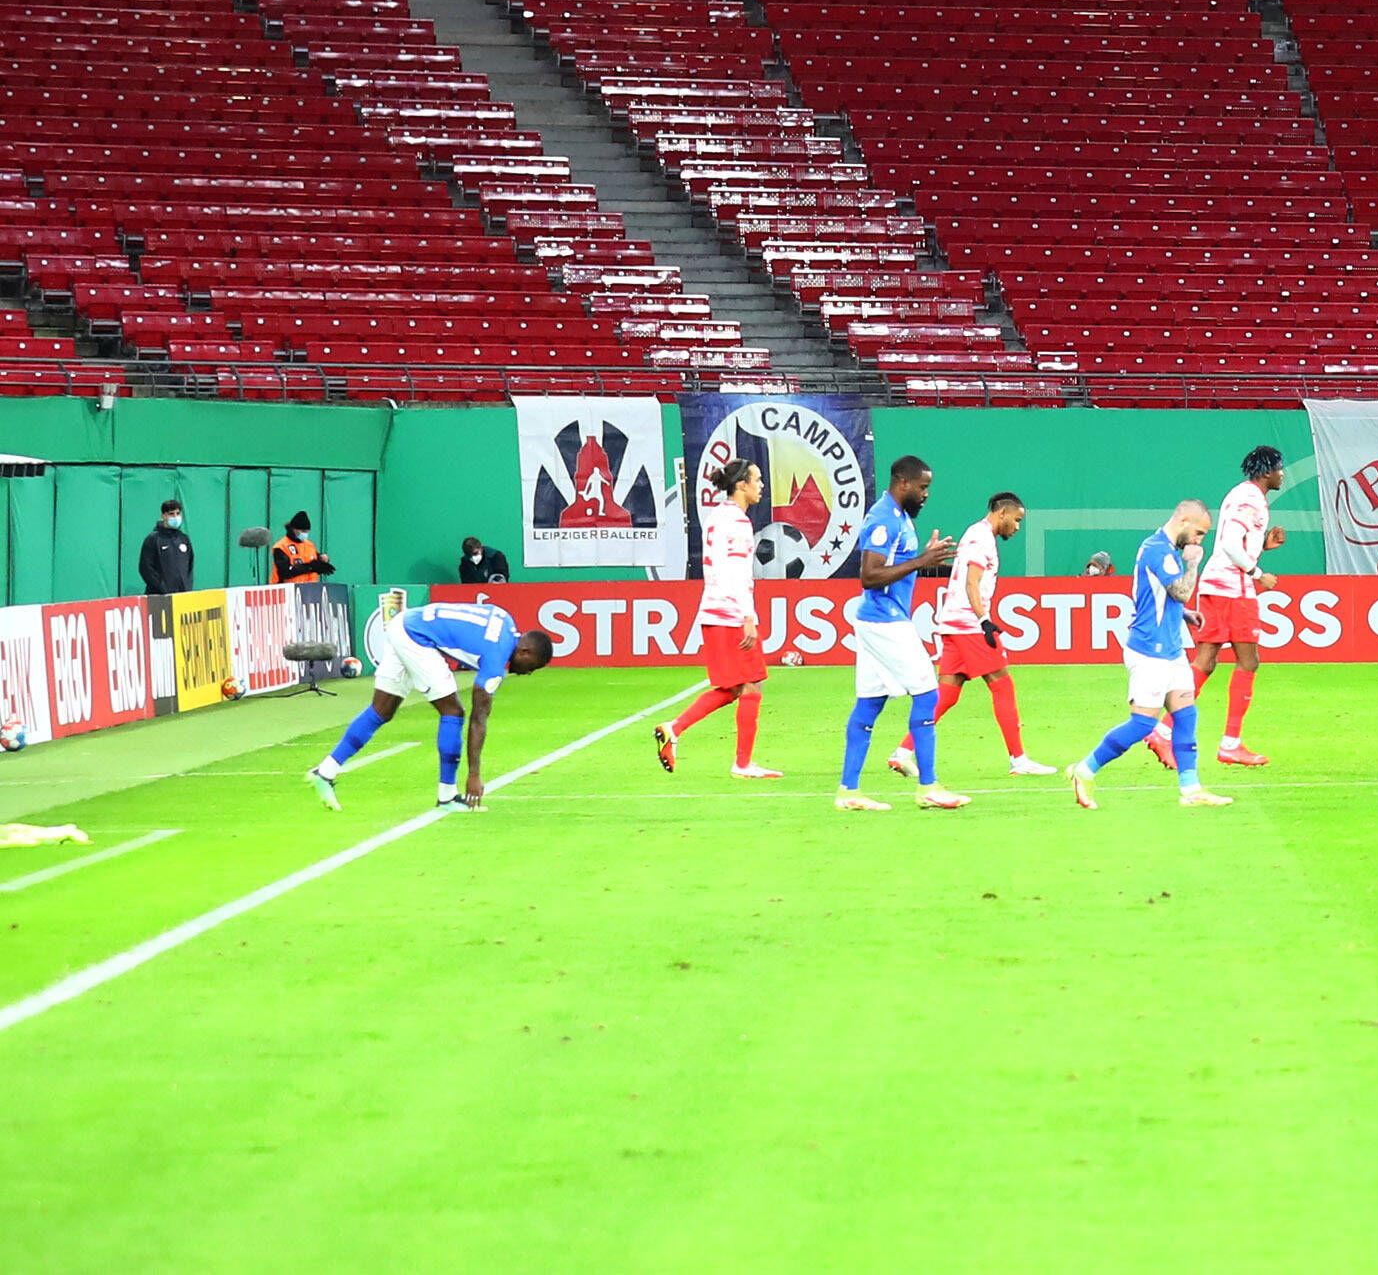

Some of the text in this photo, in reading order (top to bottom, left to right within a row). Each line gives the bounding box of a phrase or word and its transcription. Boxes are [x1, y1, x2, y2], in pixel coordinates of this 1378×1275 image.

[760, 407, 860, 509] CAMPUS
[51, 612, 92, 725] ERGO
[105, 605, 146, 713] ERGO
